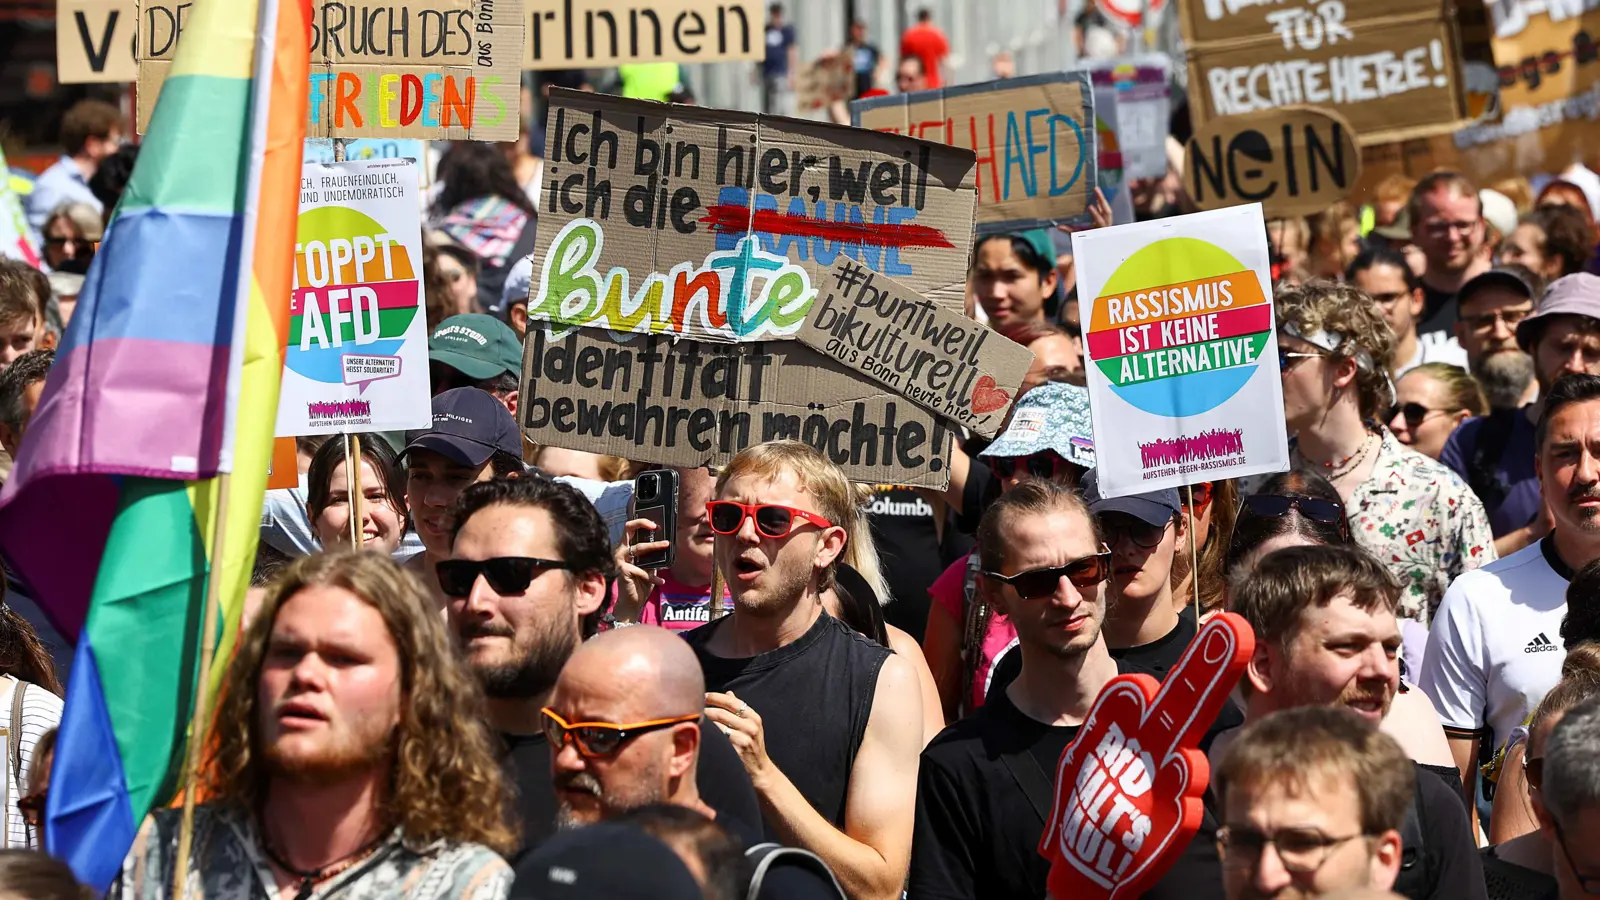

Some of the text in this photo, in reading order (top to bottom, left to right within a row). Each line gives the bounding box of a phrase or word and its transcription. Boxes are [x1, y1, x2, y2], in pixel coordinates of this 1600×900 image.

[74, 10, 138, 72] V
[417, 9, 474, 58] DES
[477, 40, 493, 67] aus
[309, 72, 508, 130] FRIEDENS
[551, 108, 619, 169] Ich
[634, 116, 700, 179] bin
[300, 186, 404, 203] UND UNDEMOKRATISCH
[549, 166, 612, 220] ich
[623, 171, 701, 234] die
[528, 218, 819, 341] bunte
[1107, 280, 1234, 325] RASSISMUS
[300, 286, 381, 351] AFD
[1119, 314, 1220, 354] IST KEINE
[531, 329, 772, 406] Identität
[813, 294, 979, 407] bikulturell
[1119, 337, 1255, 384] ALTERNATIVE
[826, 338, 992, 429] aus Bonn heute hier!
[445, 412, 473, 424] HILFIGER
[525, 378, 946, 473] bewahren möchte!
[1142, 456, 1246, 480] AUFSTEHEN-GEGEN-RASSISMUS.DE
[663, 603, 710, 622] Antifa
[1524, 644, 1558, 654] adidas
